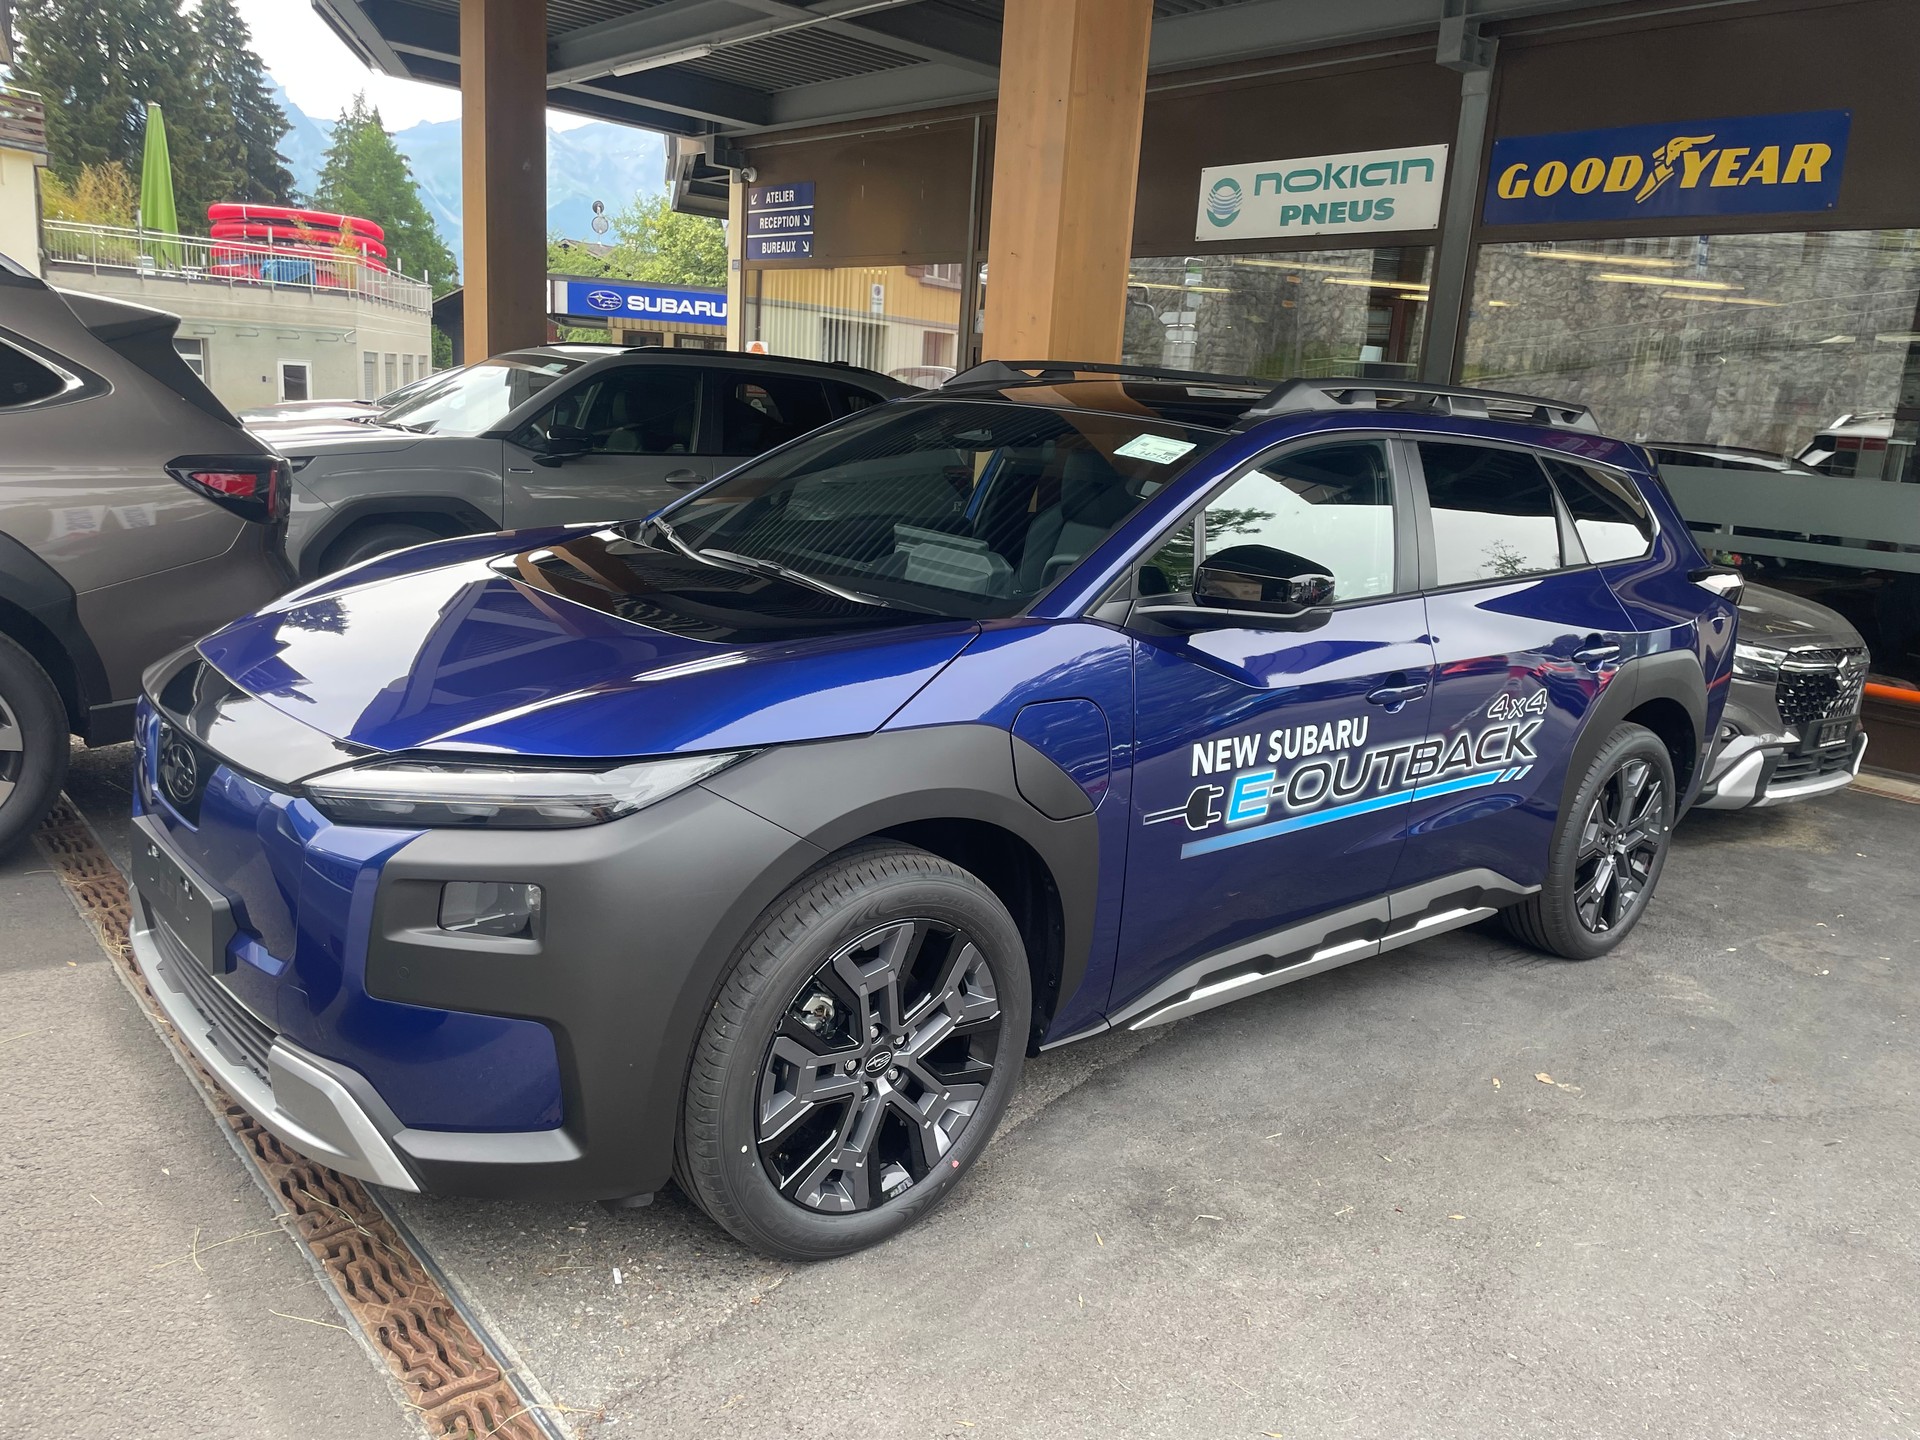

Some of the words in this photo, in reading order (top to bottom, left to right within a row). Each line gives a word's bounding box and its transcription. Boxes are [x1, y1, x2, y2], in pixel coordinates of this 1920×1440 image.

[765, 190, 795, 204] ATELIER
[759, 215, 801, 229] RECEPTION
[1279, 198, 1395, 226] PNEUS
[761, 240, 797, 254] BUREAUX
[627, 295, 727, 318] SUBARU
[1487, 688, 1548, 721] 4x4
[1191, 733, 1262, 777] NEW
[1267, 715, 1370, 764] SUBARU
[1225, 718, 1545, 825] E-OUTBACK
